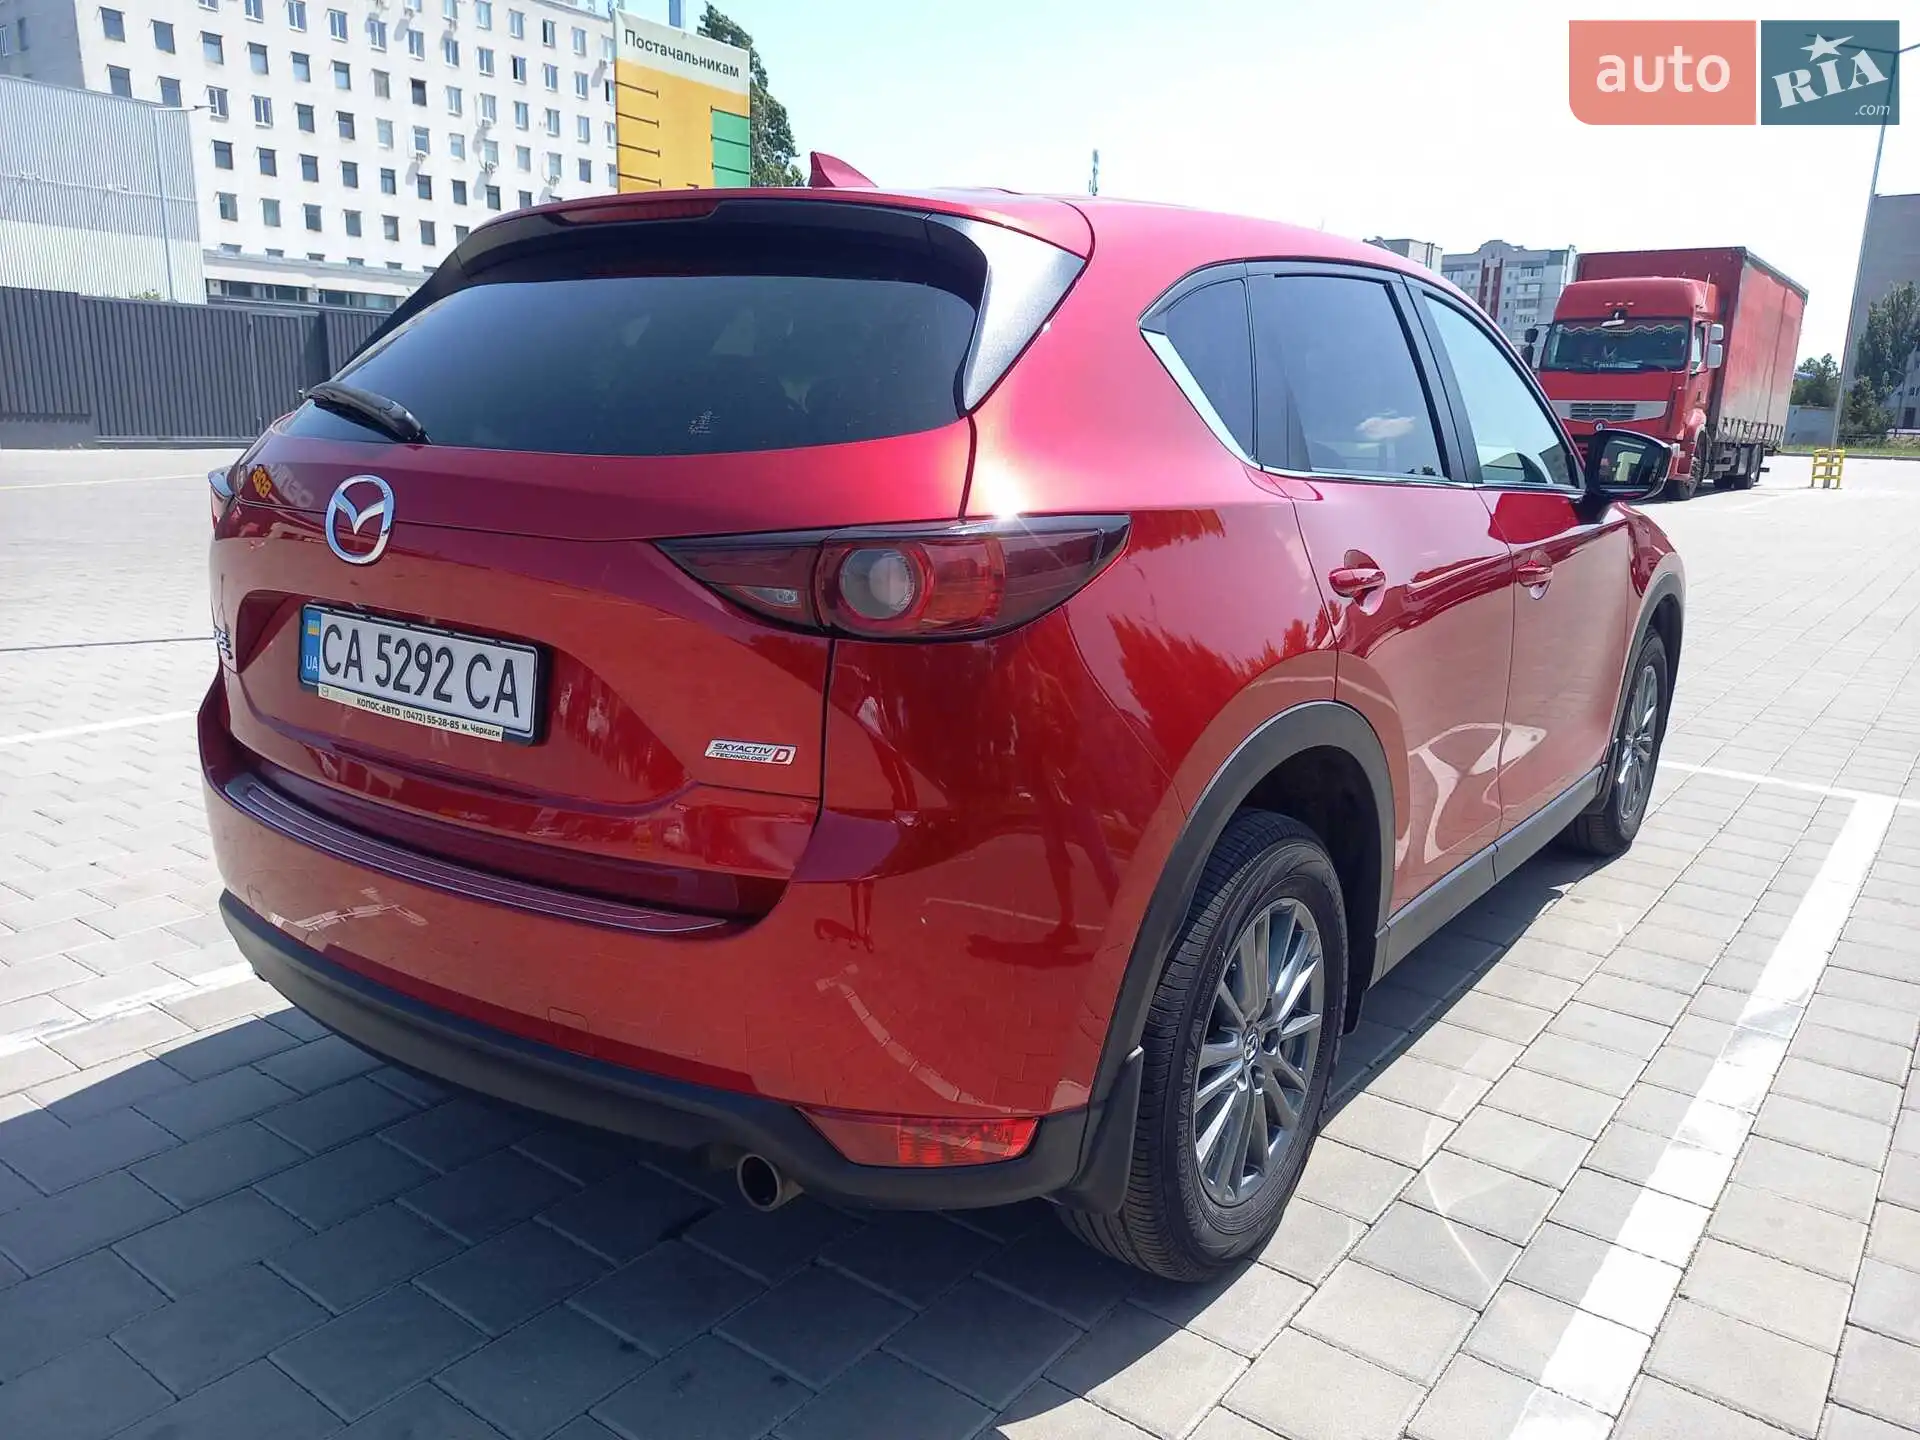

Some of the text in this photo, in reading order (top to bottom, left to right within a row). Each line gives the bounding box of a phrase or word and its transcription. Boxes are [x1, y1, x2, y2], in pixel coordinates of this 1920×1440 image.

[625, 29, 739, 78] Постачальникам
[305, 655, 318, 672] UA
[322, 623, 520, 718] CA 5292 CA
[403, 709, 426, 724] (0472)
[426, 714, 460, 730] 55-28-85
[470, 723, 501, 738] Черкаси
[712, 743, 791, 763] SKYACTIV D
[714, 752, 768, 761] TECHNOLOGY
